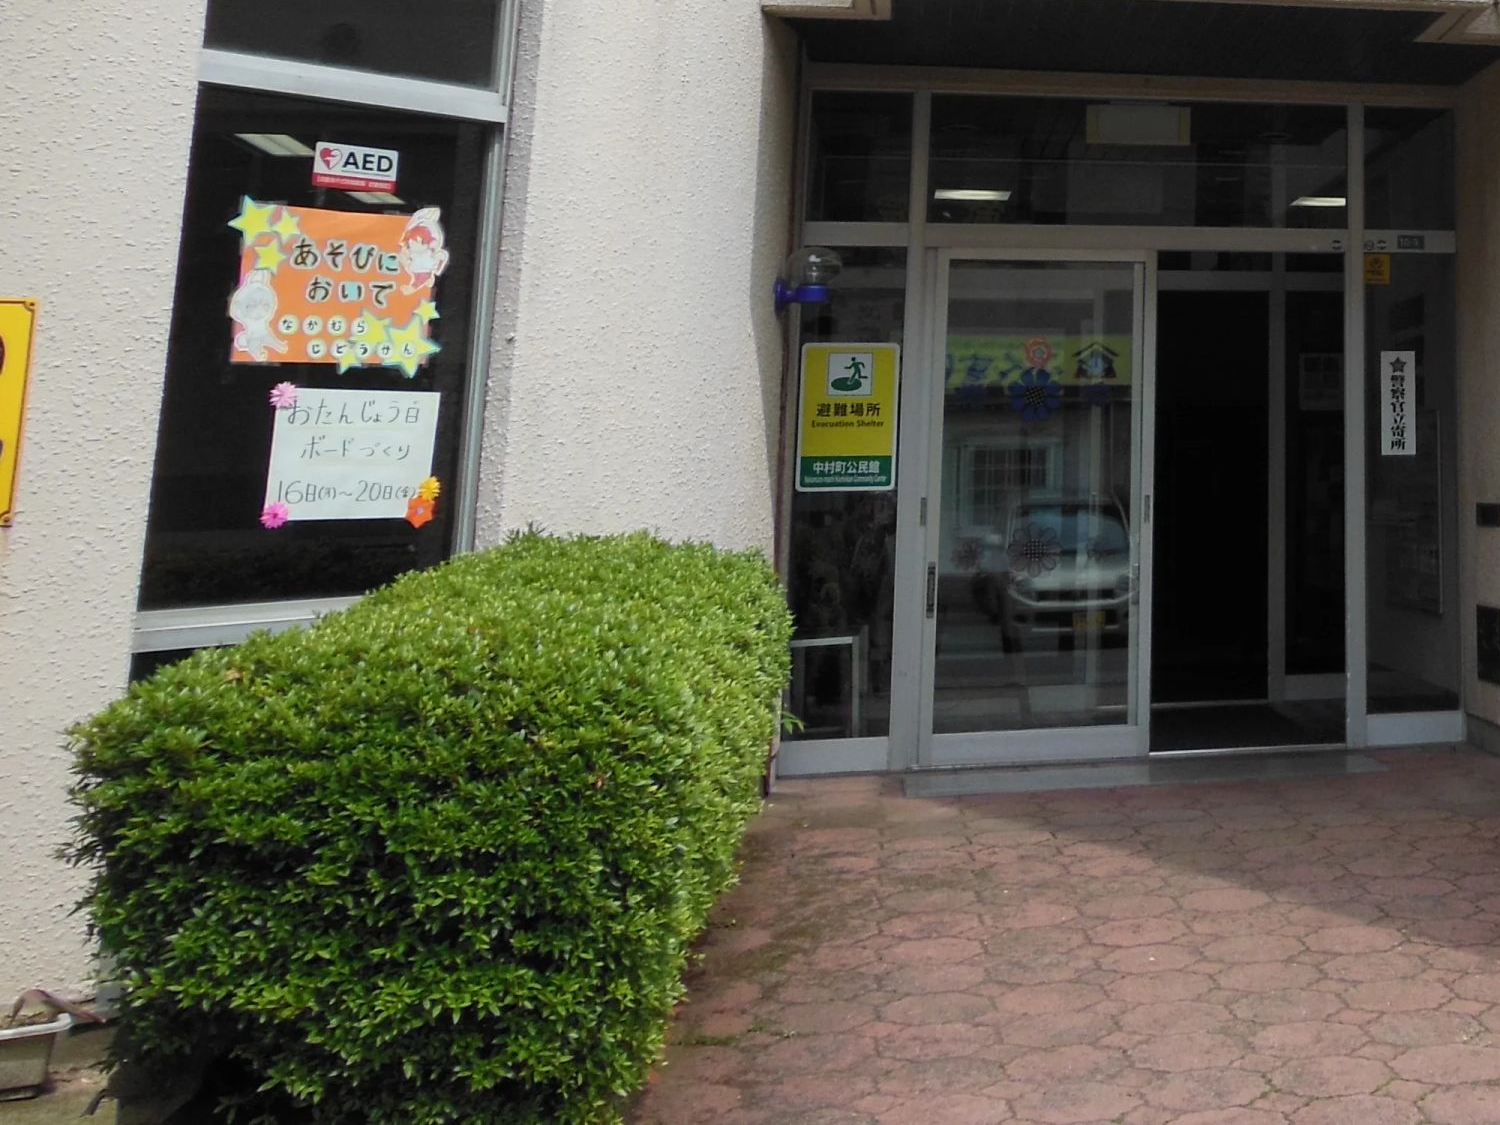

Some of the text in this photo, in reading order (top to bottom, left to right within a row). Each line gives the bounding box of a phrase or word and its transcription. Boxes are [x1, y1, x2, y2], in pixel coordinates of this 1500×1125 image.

[342, 151, 394, 173] AED
[293, 237, 399, 272] あそびに
[282, 319, 366, 333] なかむら
[286, 397, 421, 426] おたんじょう日
[816, 401, 881, 418] 避難場所
[1390, 374, 1406, 450] 警察官立寄所
[811, 419, 885, 428] Evacuation Shelter
[300, 435, 411, 461] ボードづくり
[812, 460, 881, 475] 中村町公民館
